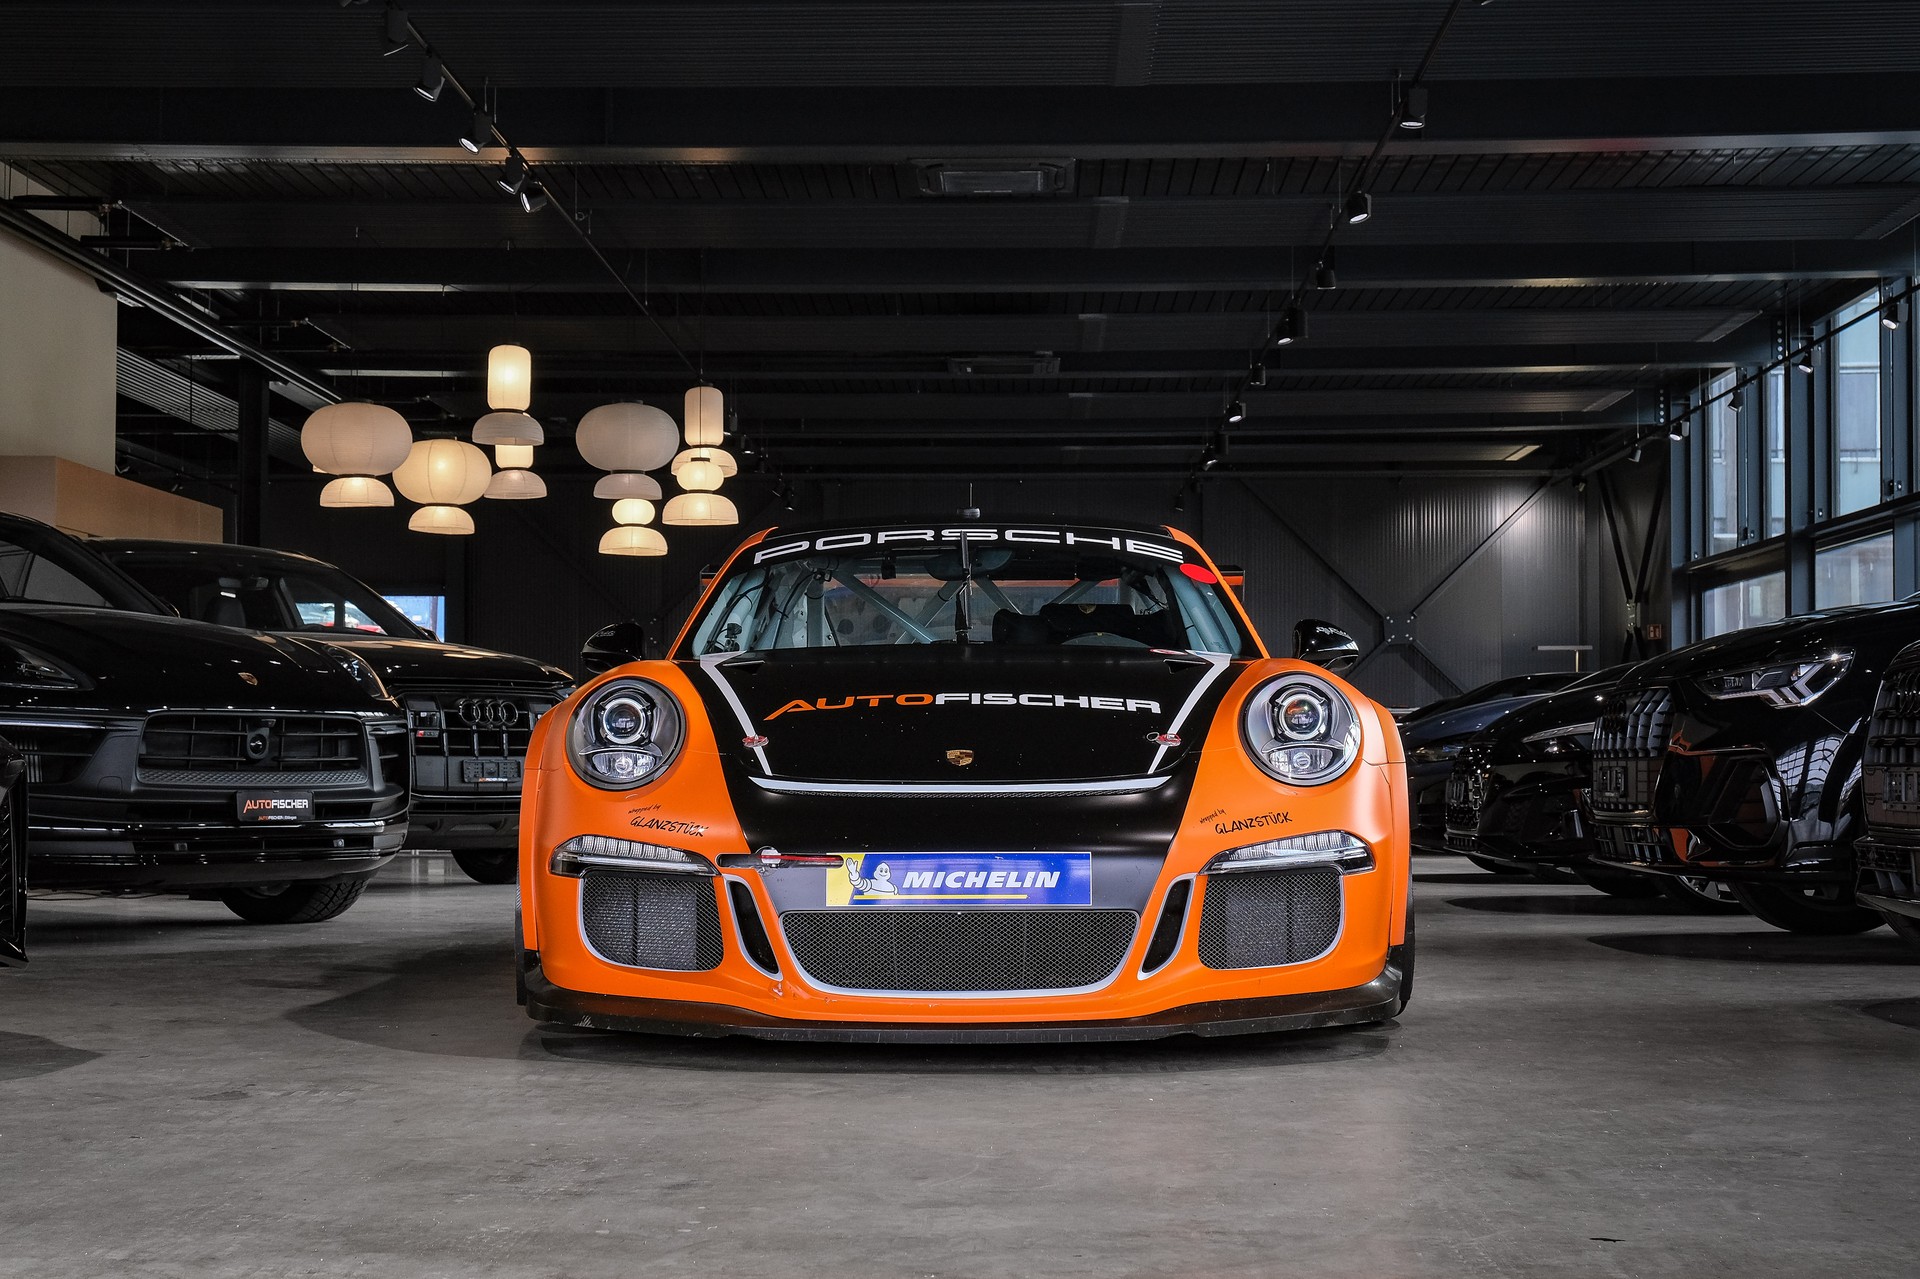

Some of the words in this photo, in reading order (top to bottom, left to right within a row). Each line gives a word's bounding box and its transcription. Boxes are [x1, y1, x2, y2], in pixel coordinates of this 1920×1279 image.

[753, 528, 1185, 565] PORSCHE
[763, 692, 1162, 721] AUTOFISCHER
[243, 799, 309, 814] AUTOFISCHER
[1215, 812, 1292, 834] GLANZSTÜCK
[902, 871, 1061, 888] MICHELIN
